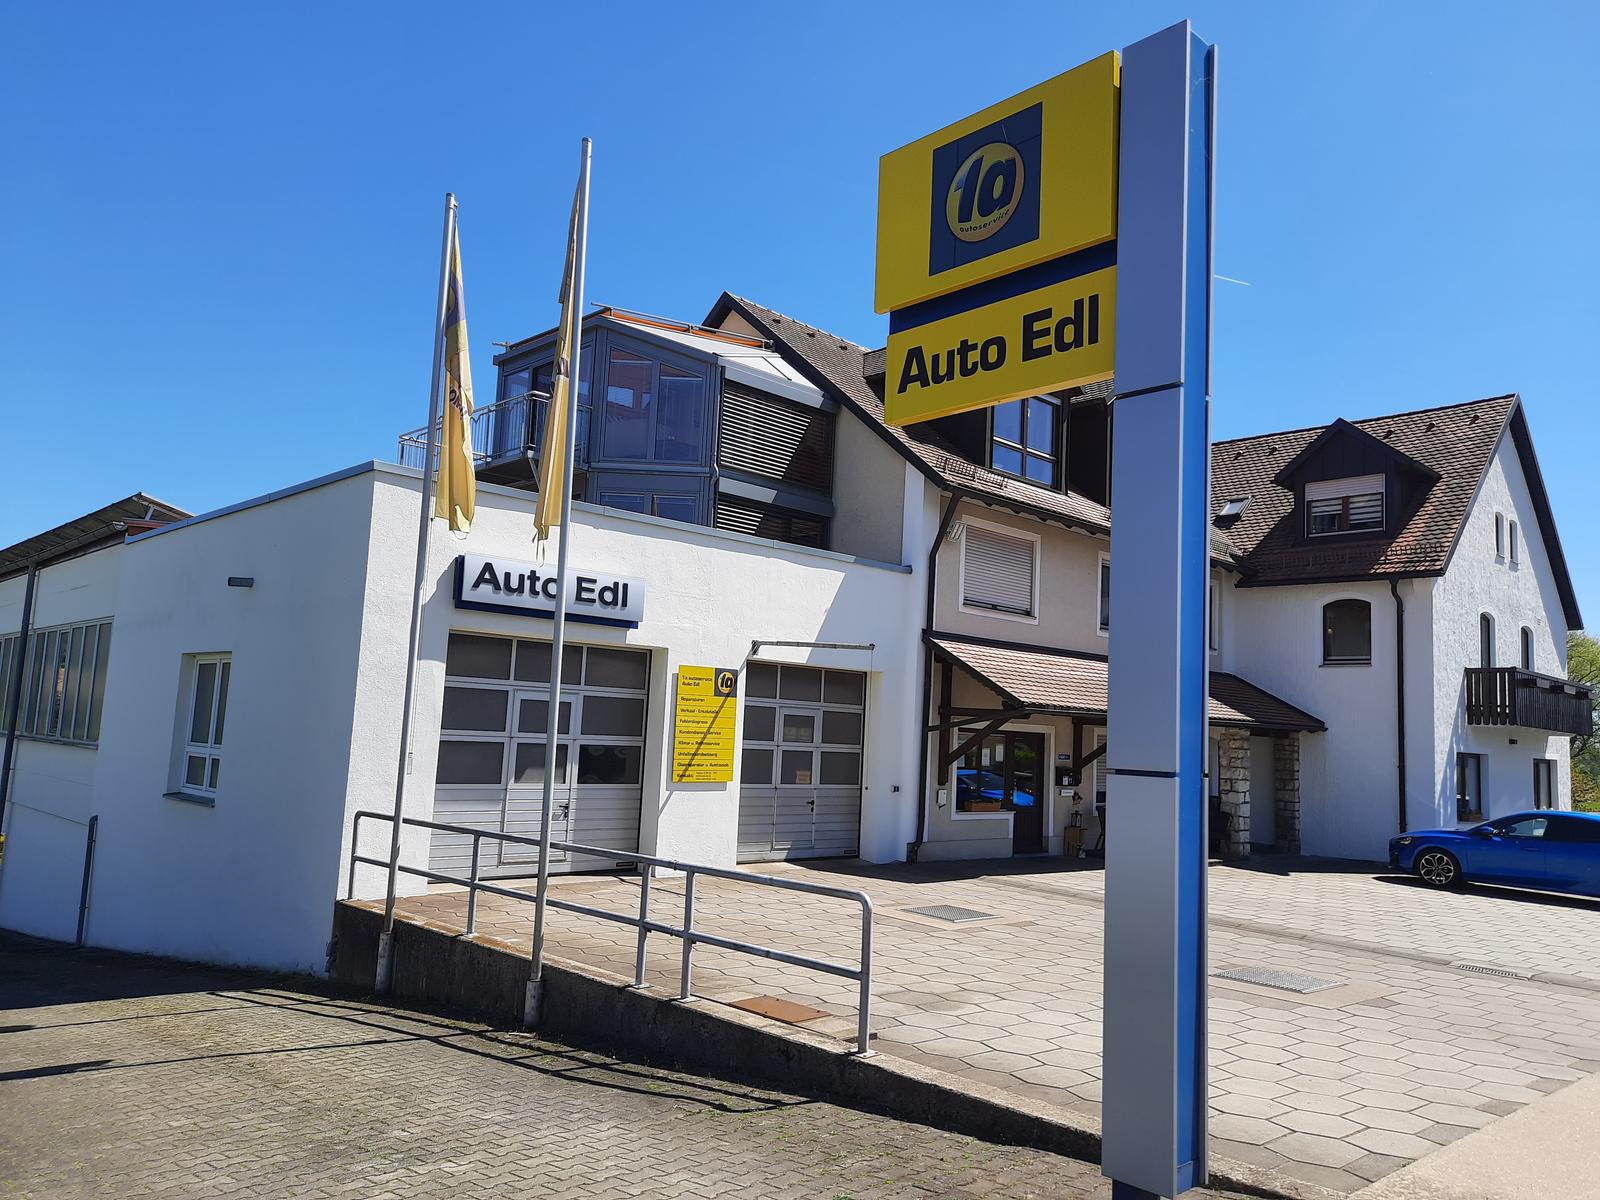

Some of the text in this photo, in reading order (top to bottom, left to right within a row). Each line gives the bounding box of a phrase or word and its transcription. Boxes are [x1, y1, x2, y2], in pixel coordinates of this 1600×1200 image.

[954, 155, 1016, 223] 1a
[897, 293, 1100, 395] Auto Edl
[472, 561, 629, 608] Auto Edl
